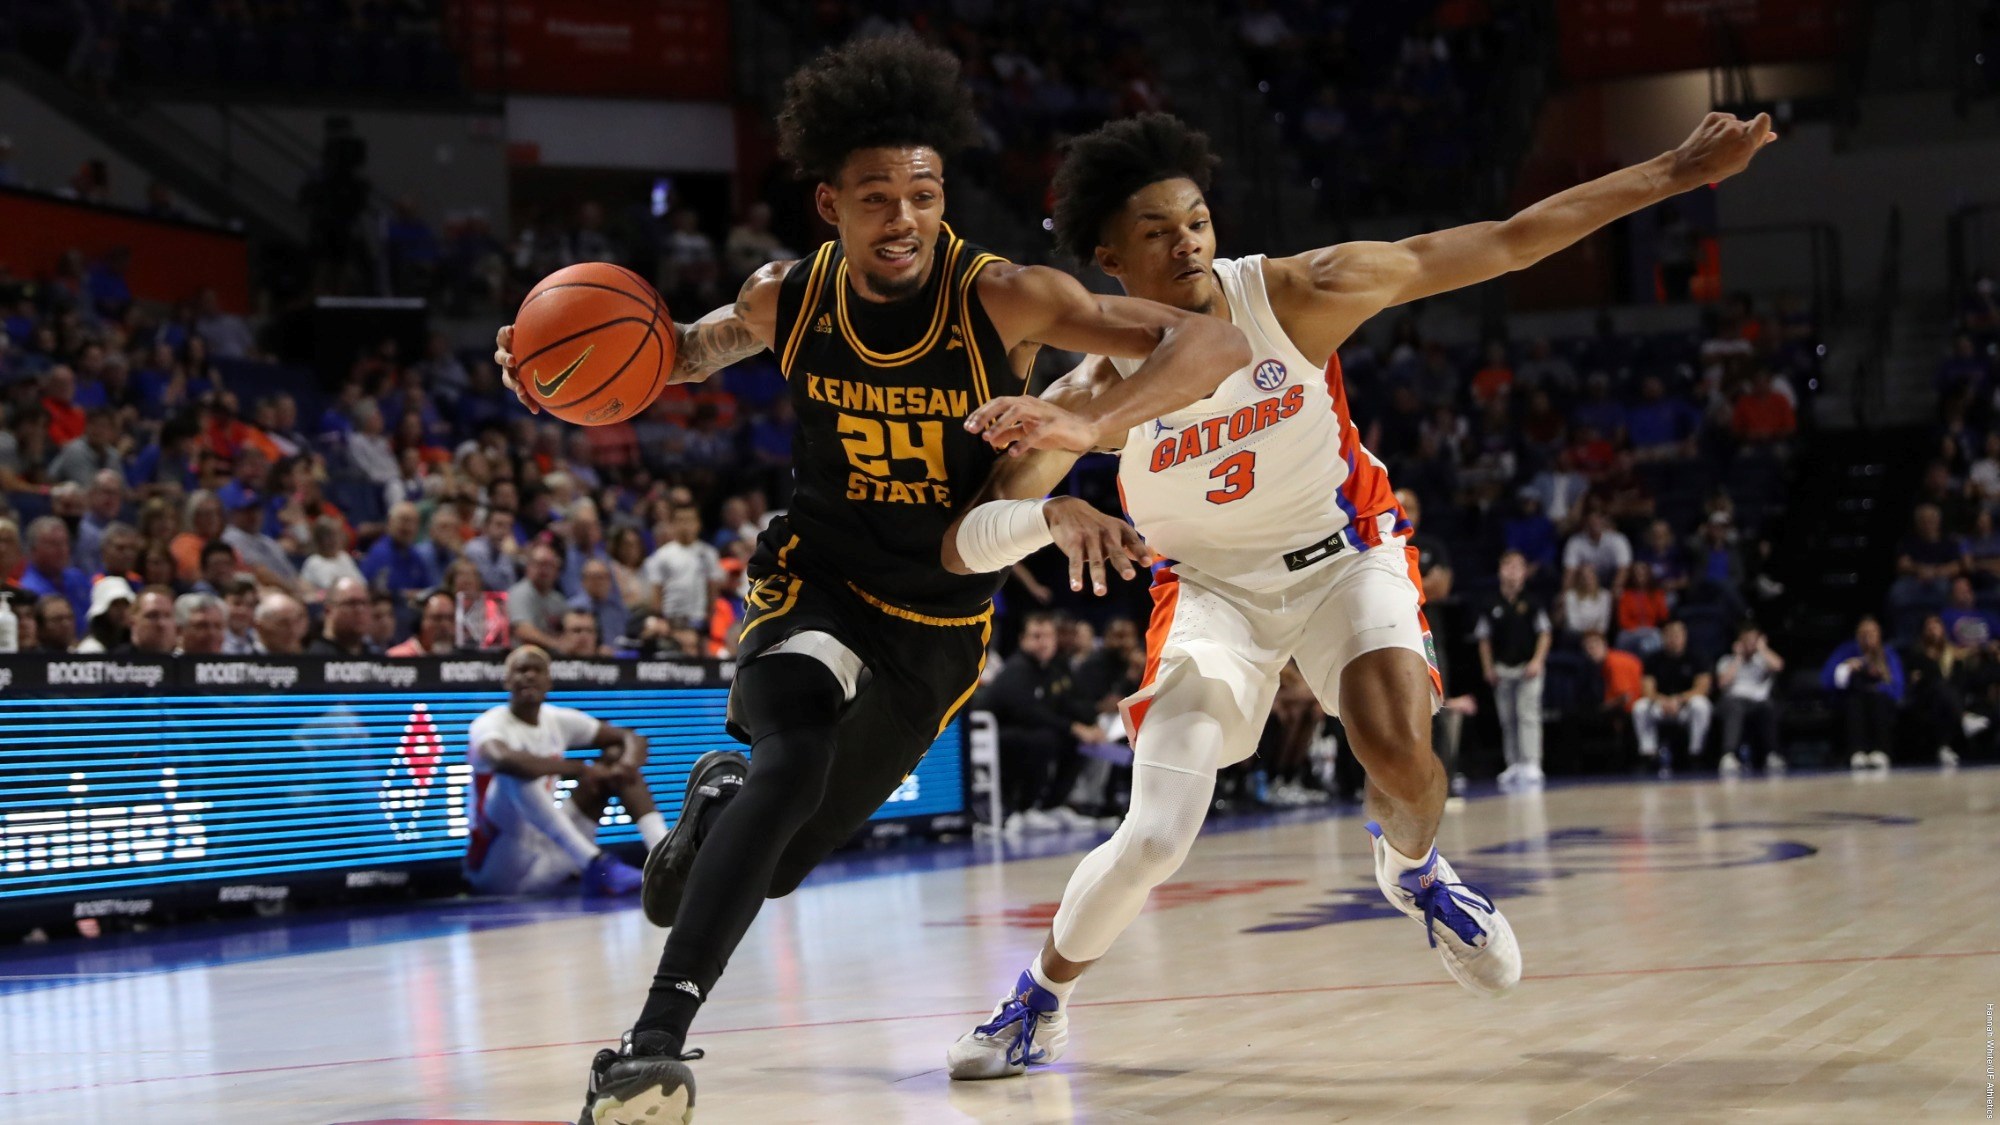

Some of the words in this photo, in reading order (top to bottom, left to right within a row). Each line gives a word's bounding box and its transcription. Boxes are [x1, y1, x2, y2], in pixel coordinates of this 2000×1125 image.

[1255, 362, 1285, 389] SEC
[837, 412, 948, 481] 24
[1149, 384, 1304, 473] GATORS
[847, 472, 951, 508] STATE
[1206, 450, 1256, 505] 3
[48, 661, 102, 685] ROCKET
[195, 662, 246, 684] ROCKET
